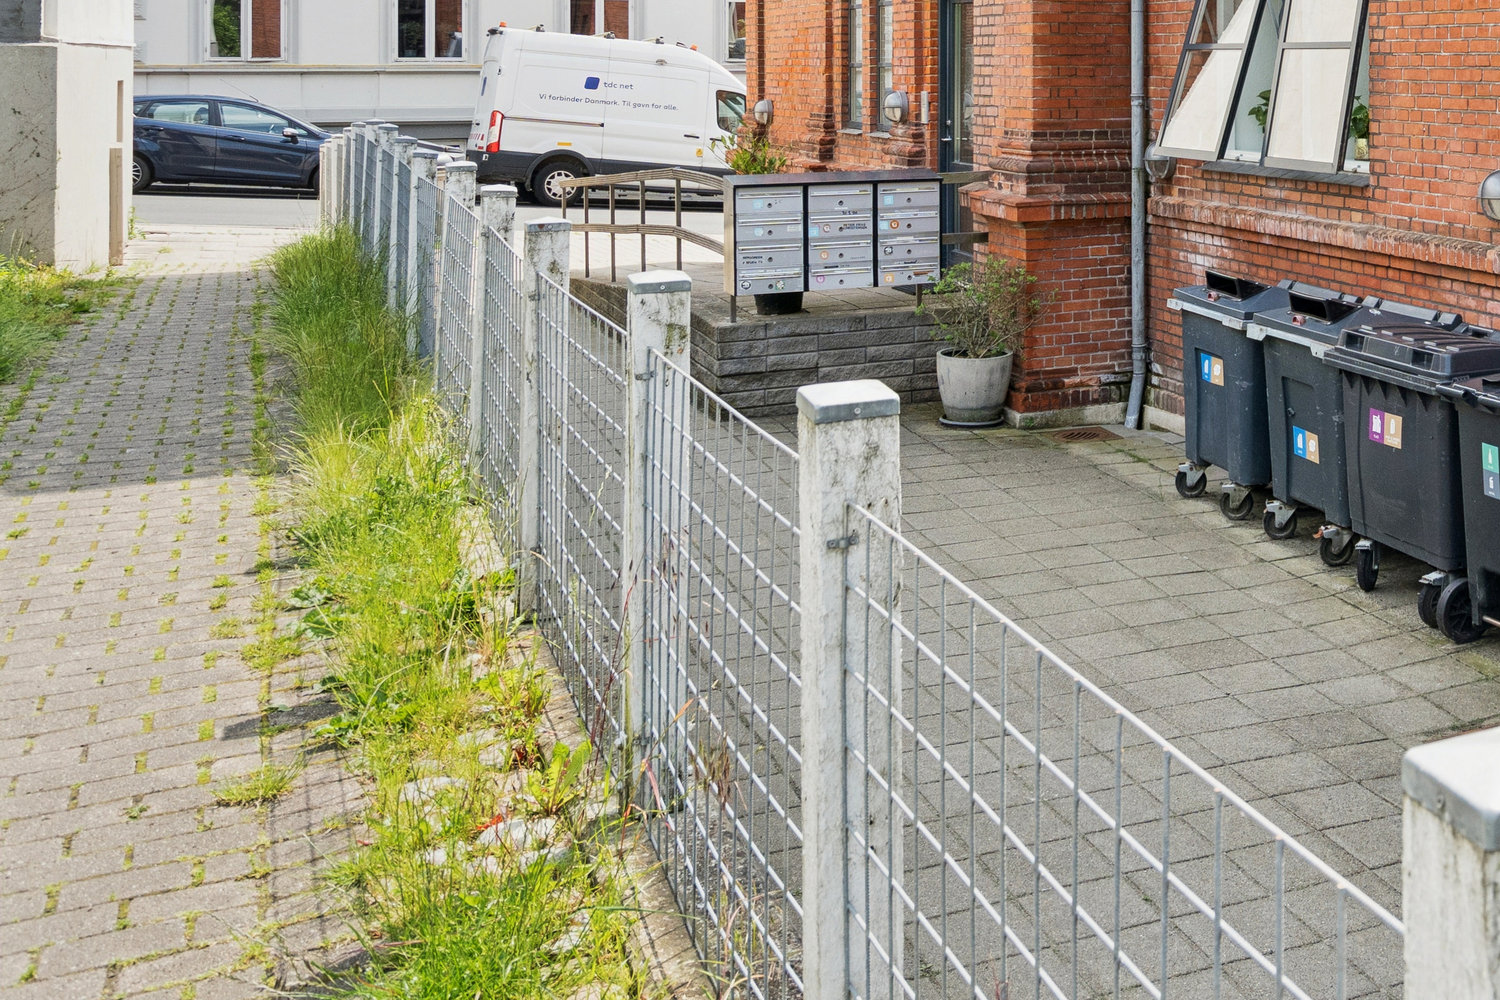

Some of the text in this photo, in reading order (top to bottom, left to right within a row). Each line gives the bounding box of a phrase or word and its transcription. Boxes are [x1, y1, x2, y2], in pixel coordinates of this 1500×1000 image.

[603, 81, 634, 90] tdc net
[548, 94, 583, 103] forbinder
[584, 97, 620, 106] Danmark.
